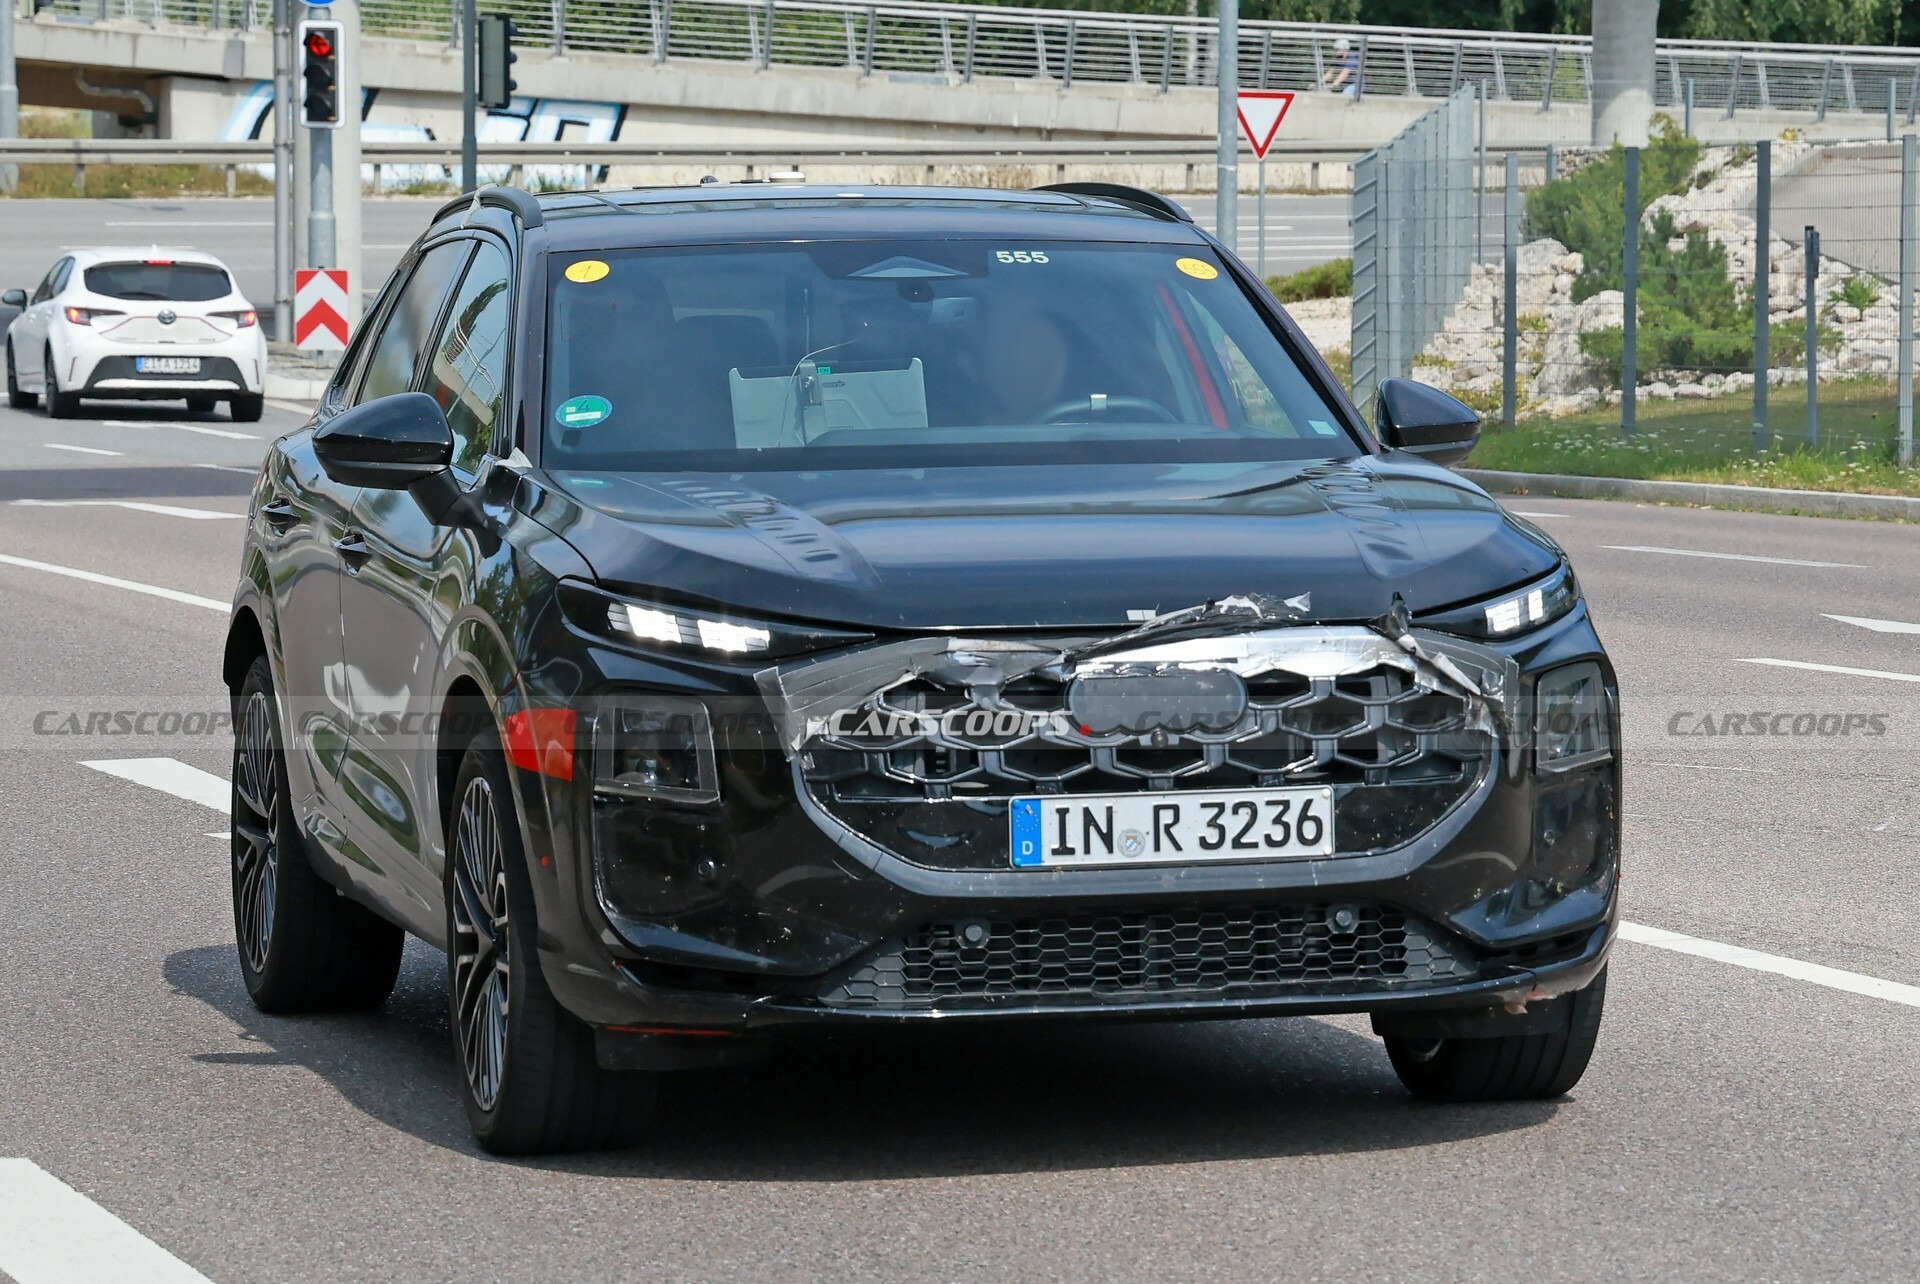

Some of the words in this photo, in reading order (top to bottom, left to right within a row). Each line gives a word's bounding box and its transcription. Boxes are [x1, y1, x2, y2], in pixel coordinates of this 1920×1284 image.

[996, 251, 1050, 264] 555
[577, 399, 591, 412] 4
[1022, 842, 1034, 855] D
[1051, 806, 1113, 856] IN
[1153, 803, 1183, 852] R
[1198, 798, 1324, 850] 3236
